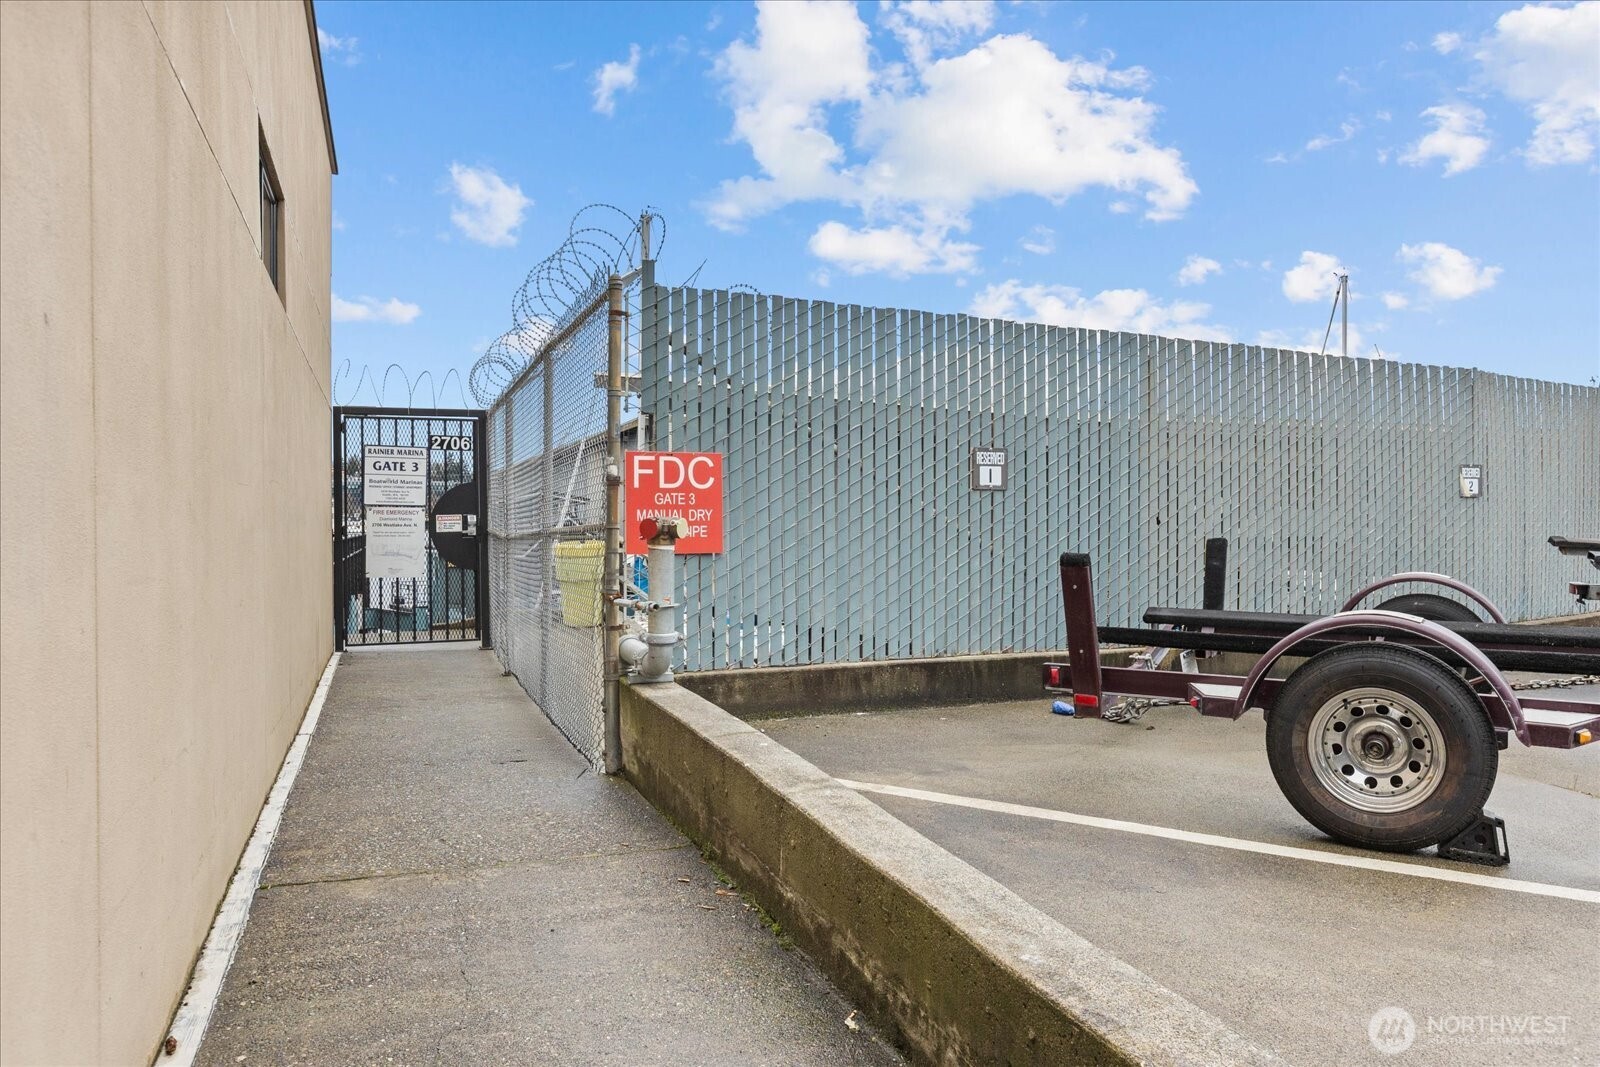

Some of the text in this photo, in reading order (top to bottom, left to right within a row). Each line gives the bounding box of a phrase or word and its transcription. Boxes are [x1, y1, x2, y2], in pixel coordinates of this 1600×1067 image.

[431, 436, 470, 449] 2706
[367, 448, 395, 456] RAINIER
[976, 451, 1004, 464] RESERVED
[372, 460, 419, 472] GATE 3
[633, 455, 715, 489] FDC
[1469, 481, 1474, 492] 2
[654, 492, 696, 505] GATE 3
[688, 509, 713, 521] DRY
